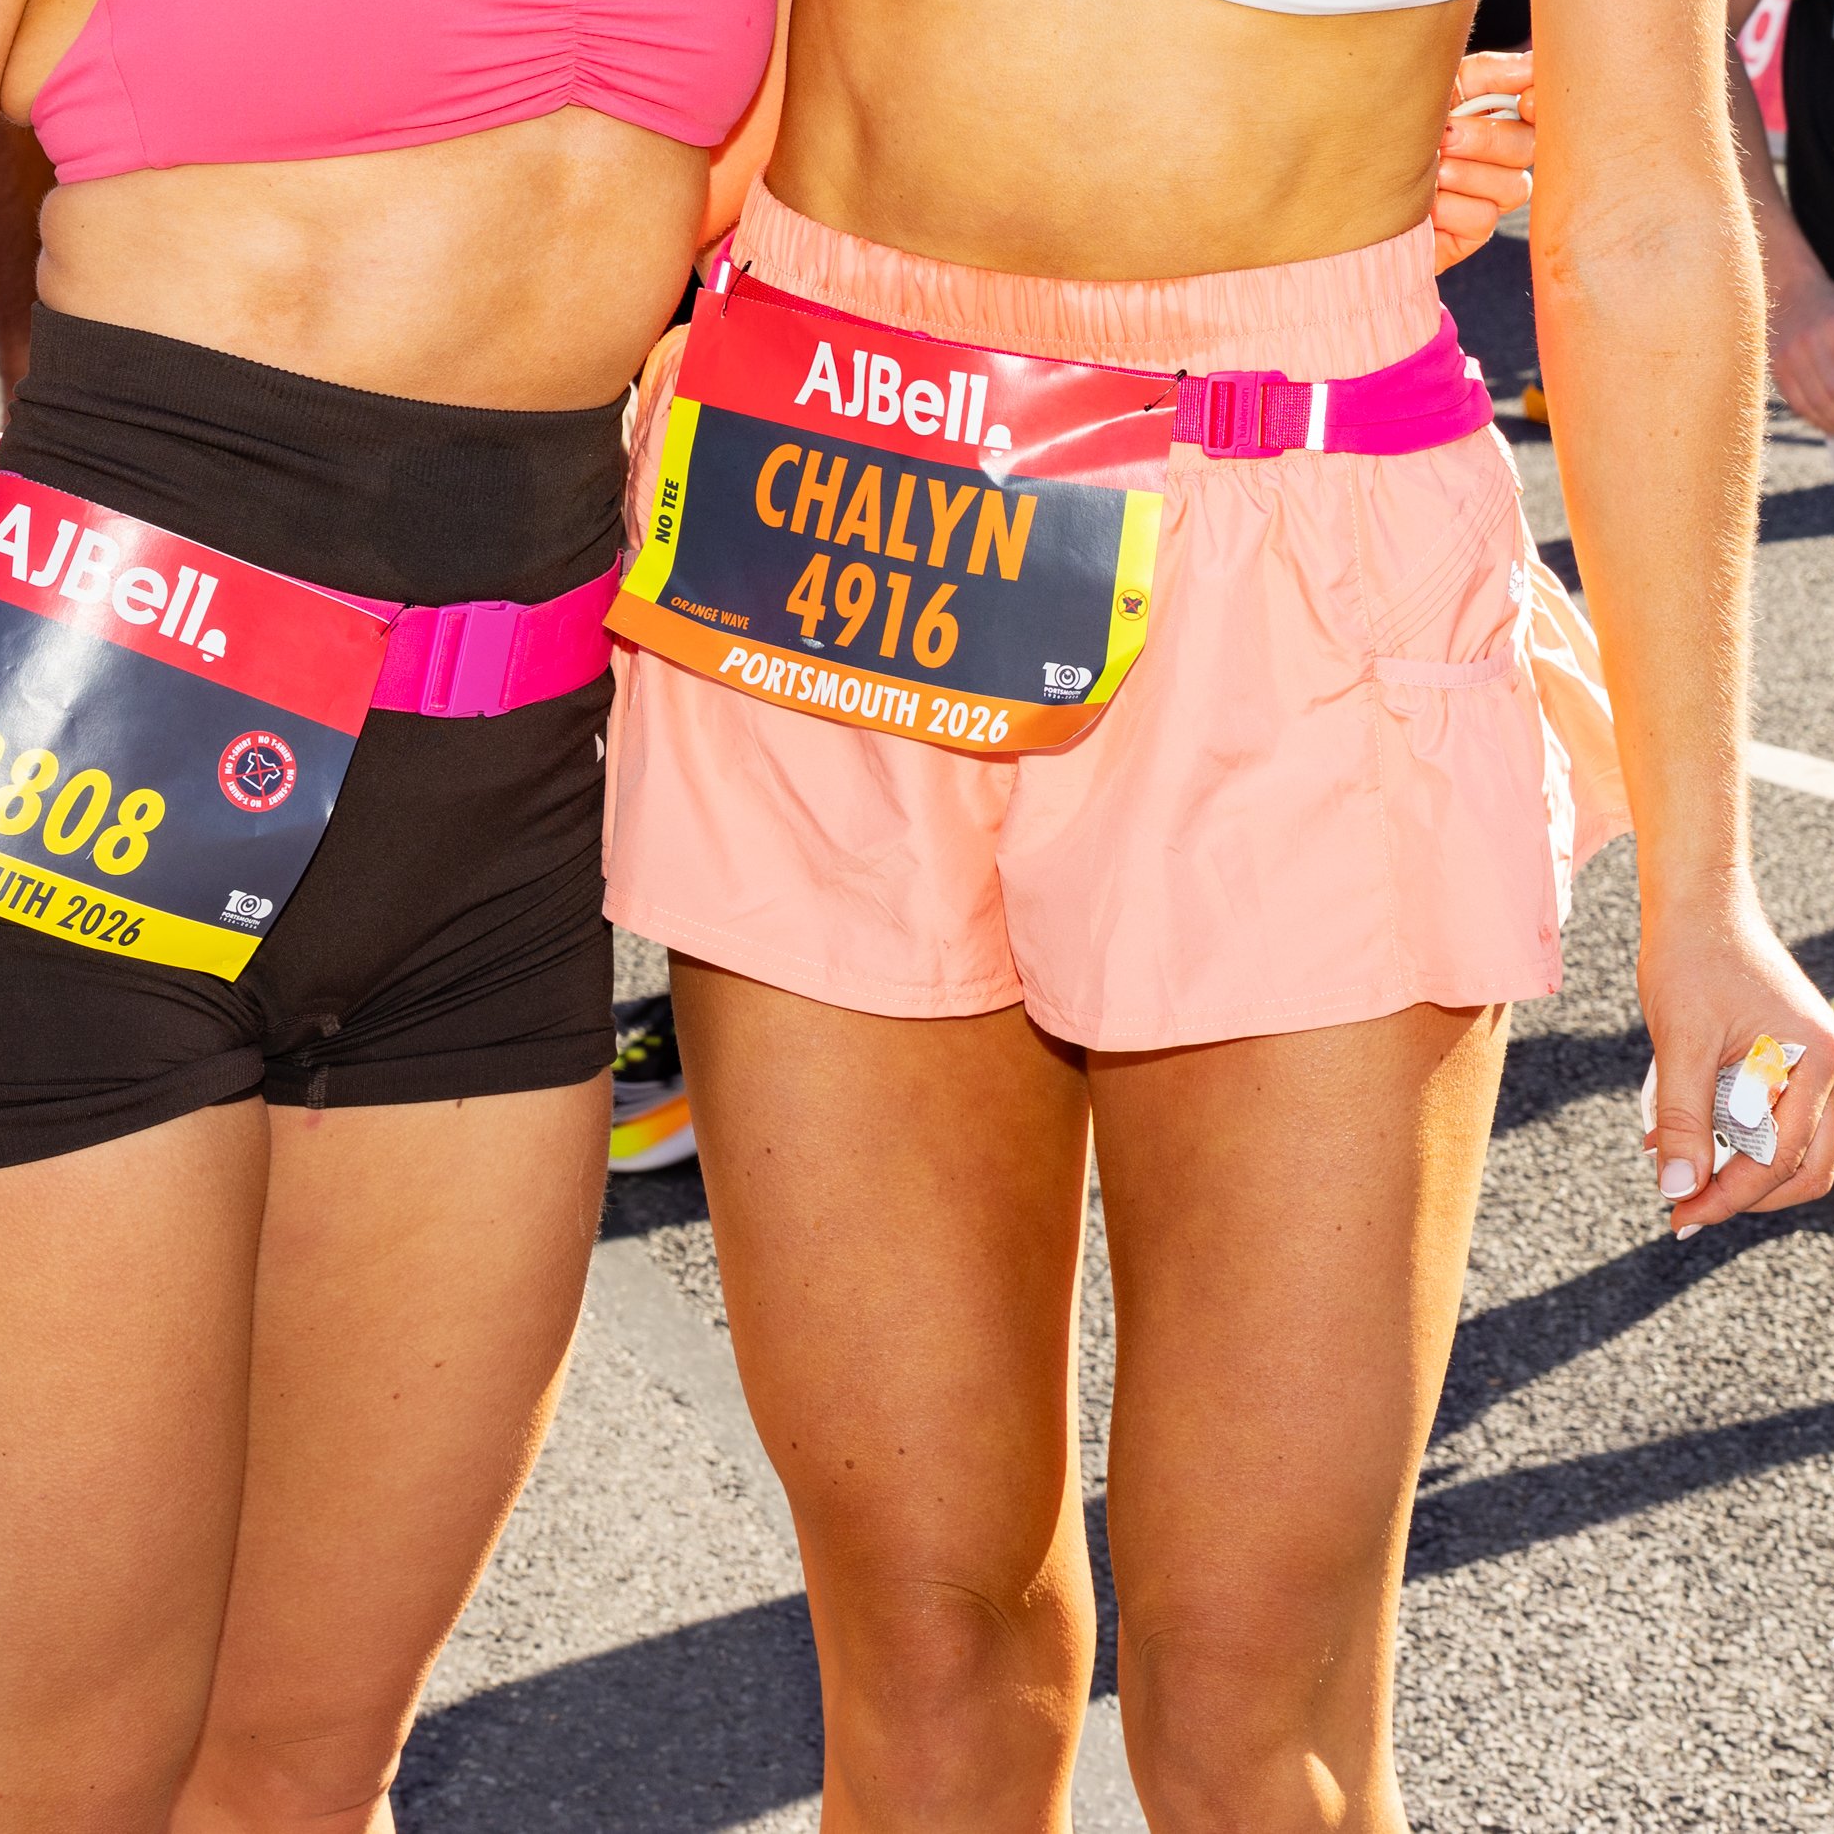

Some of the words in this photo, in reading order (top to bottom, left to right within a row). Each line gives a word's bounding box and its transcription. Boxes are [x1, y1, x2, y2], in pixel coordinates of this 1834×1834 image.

[794, 341, 988, 447] AJBell
[660, 478, 679, 510] TEE
[755, 443, 1039, 582] CHALYN
[655, 515, 673, 544] NO
[670, 596, 719, 623] ORANGE
[720, 612, 749, 630] WAVE
[786, 553, 959, 669] 4916
[719, 646, 920, 728] PORTSMOUTH
[926, 697, 1009, 744] 2026
[258, 735, 270, 744] NO
[57, 895, 146, 947] 2026
